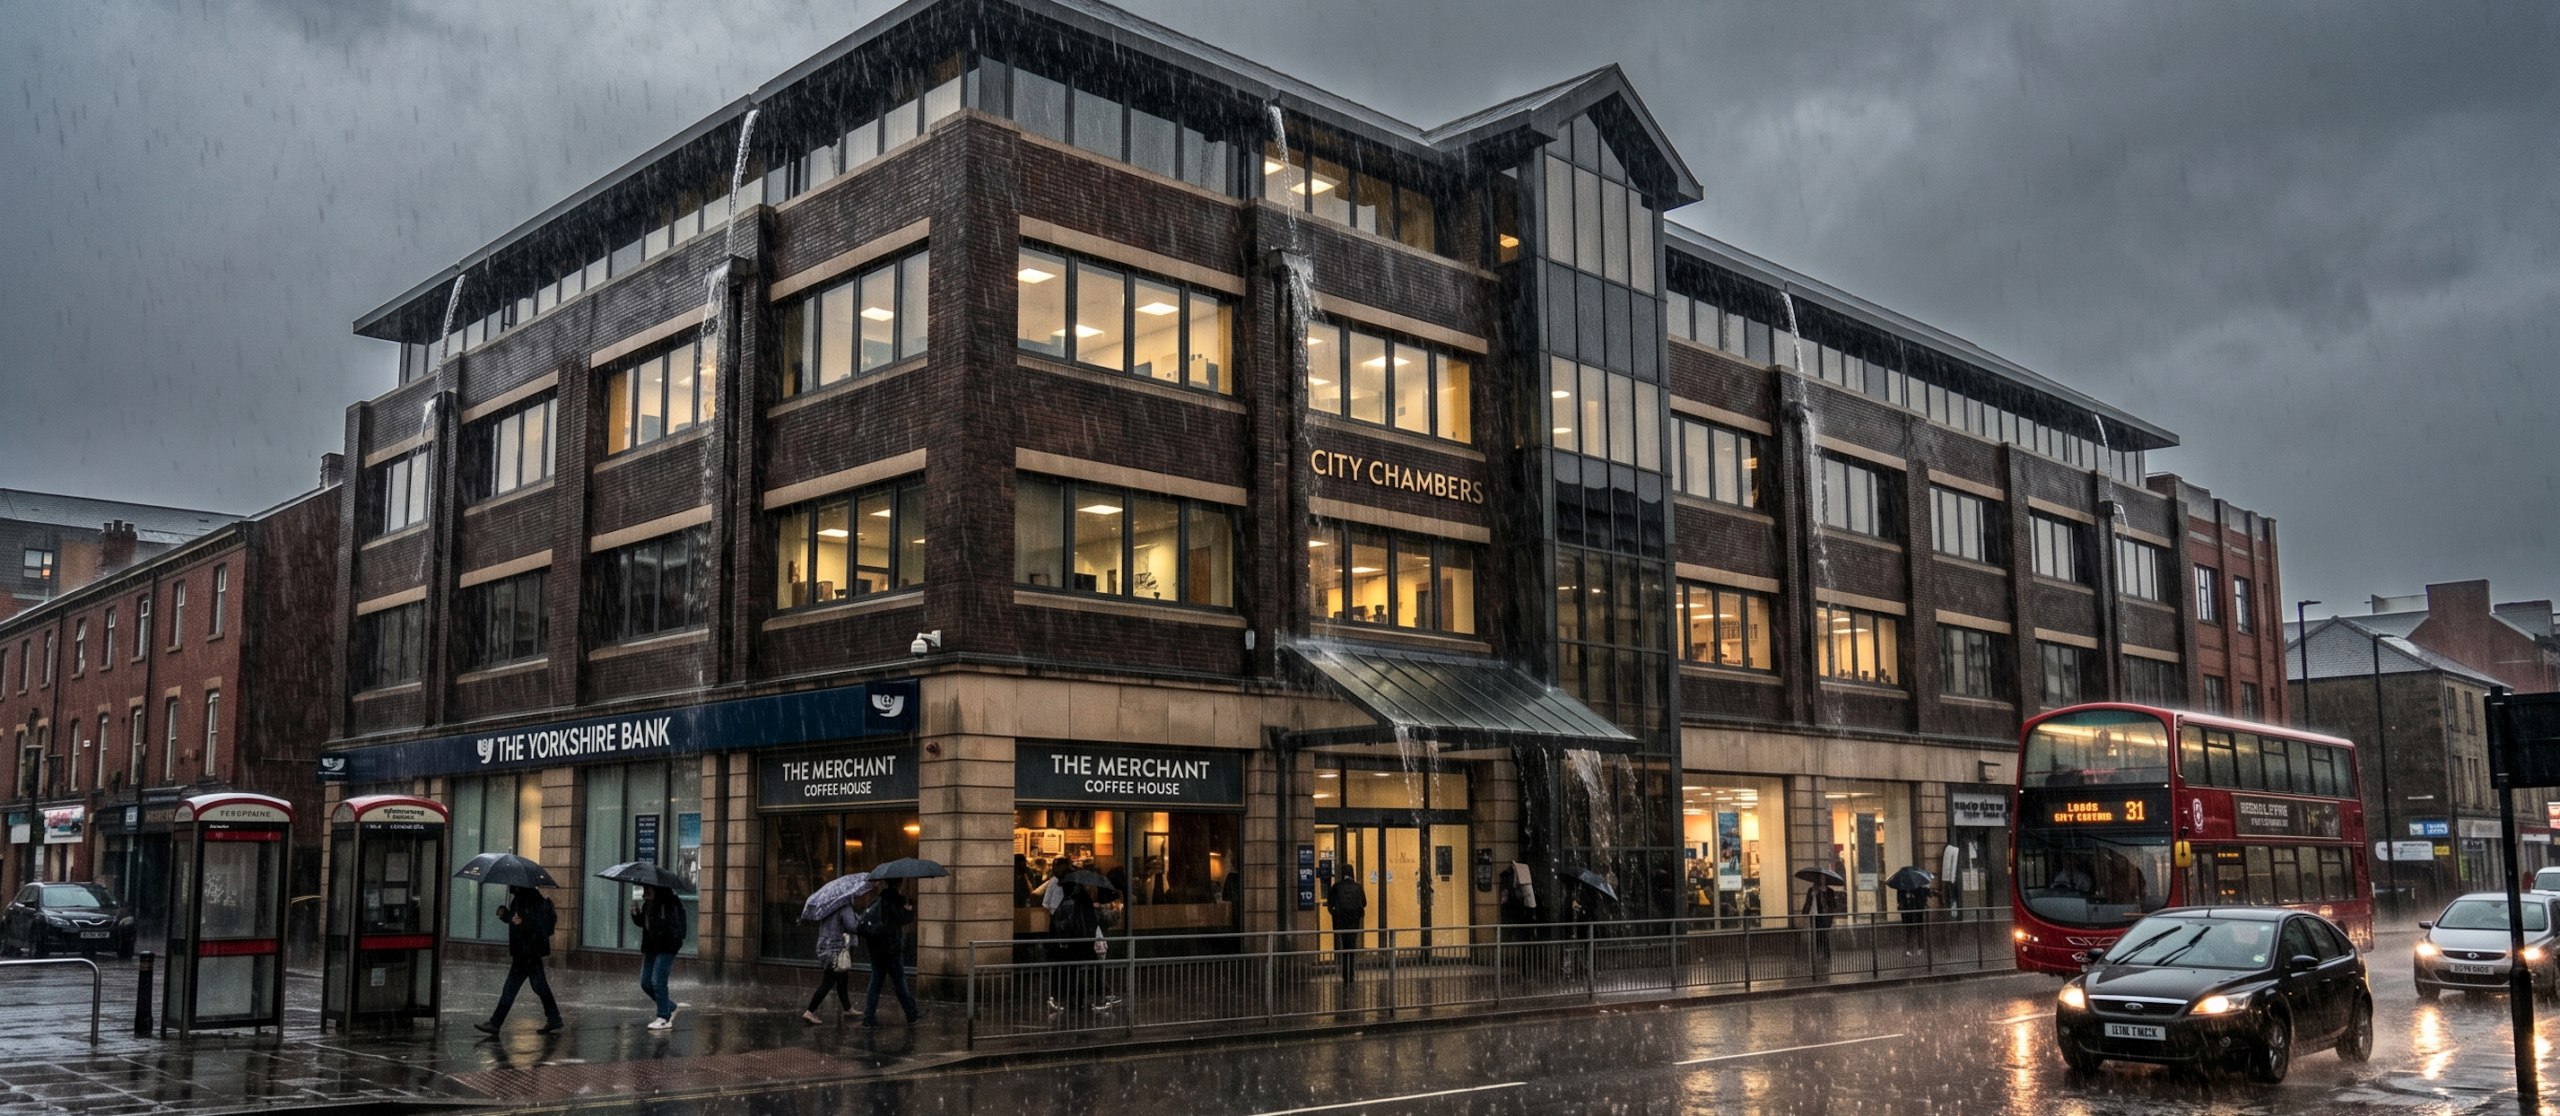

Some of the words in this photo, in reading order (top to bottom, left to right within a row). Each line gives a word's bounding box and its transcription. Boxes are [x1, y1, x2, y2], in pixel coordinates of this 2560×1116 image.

[1310, 449, 1363, 481] CITY
[1369, 460, 1484, 504] CHAMBERS
[497, 734, 525, 762] THE
[528, 723, 617, 760] YORKSHIRE
[621, 716, 671, 750] BANK
[782, 761, 809, 781] THE
[812, 755, 896, 780] MERCHANT
[1051, 754, 1092, 775] THE
[1098, 756, 1210, 780] MERCHANT
[804, 783, 838, 797] COFFEE
[840, 781, 872, 795] HOUSE
[1084, 779, 1134, 794] COFFEE
[1137, 782, 1180, 795] HOUSE
[2125, 800, 2145, 820] 31
